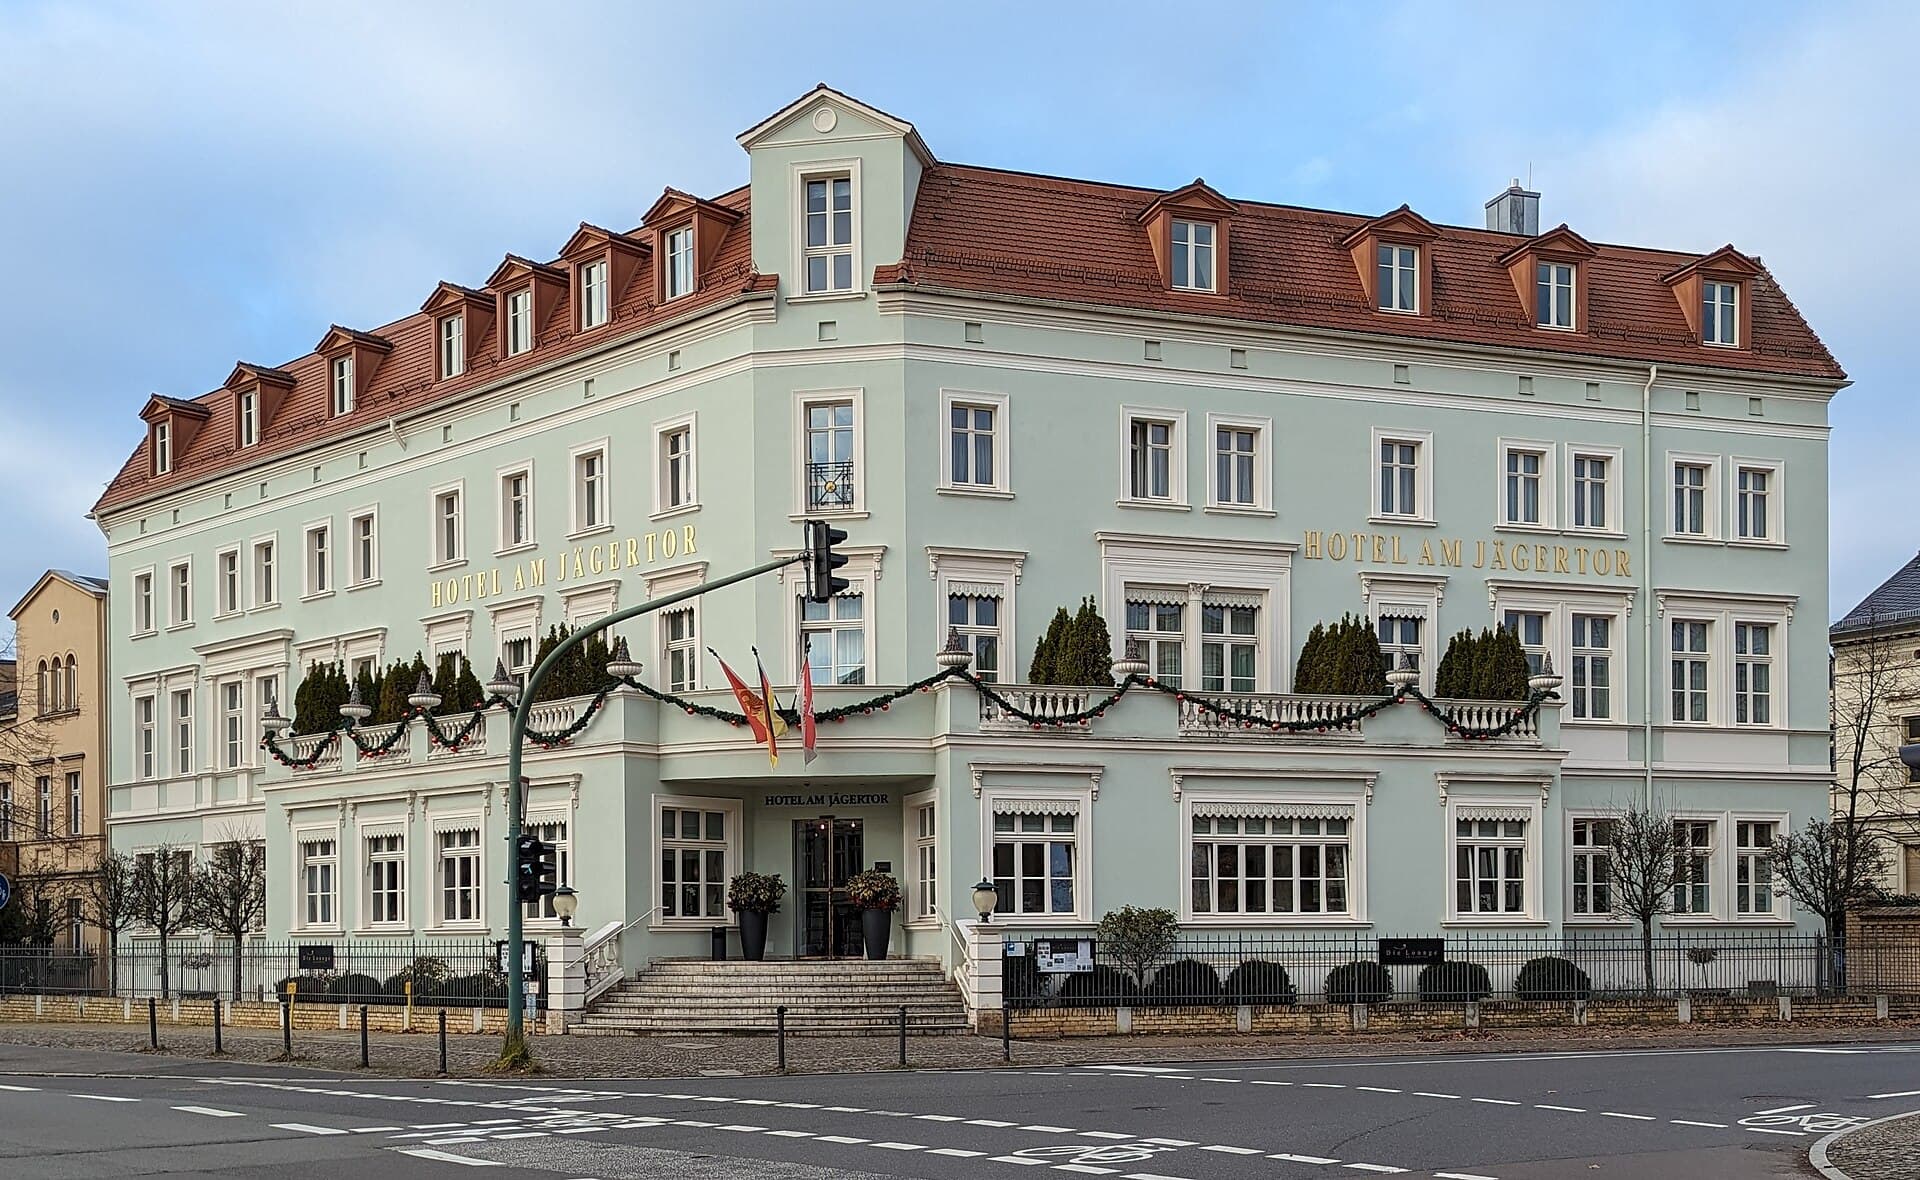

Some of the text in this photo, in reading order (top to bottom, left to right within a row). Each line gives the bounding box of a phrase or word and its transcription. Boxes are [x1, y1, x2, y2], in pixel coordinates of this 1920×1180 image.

[431, 524, 697, 608] HOTEL AM JÄGERTOR
[1303, 530, 1632, 577] HOTEL AM JÄGERTOR
[765, 792, 889, 807] HOTEL AM JÄGERTOR
